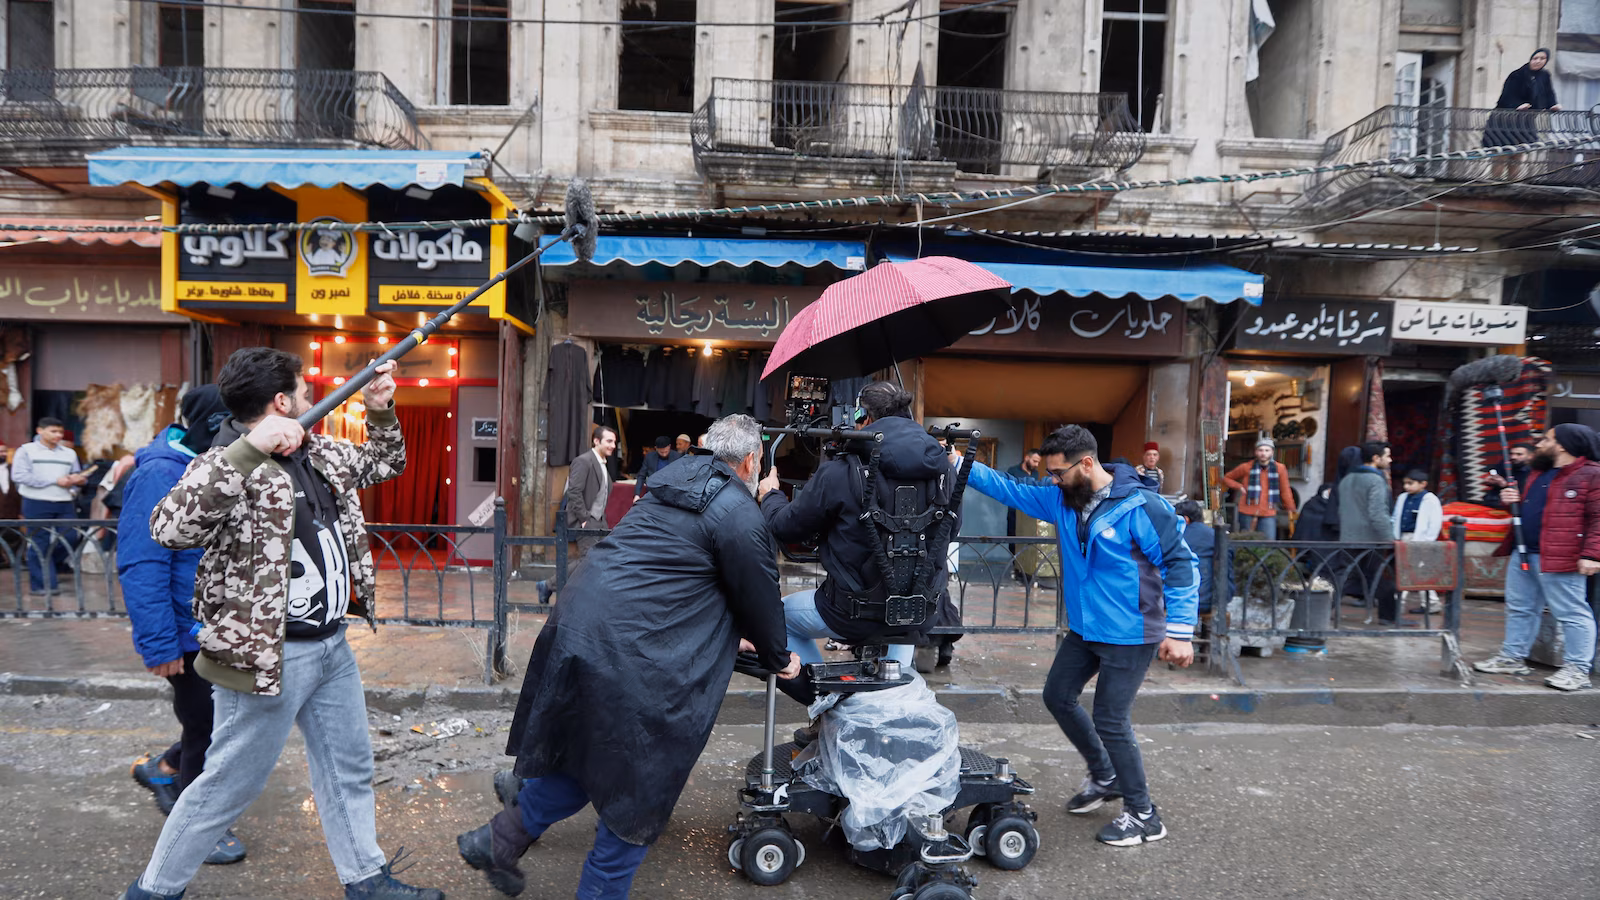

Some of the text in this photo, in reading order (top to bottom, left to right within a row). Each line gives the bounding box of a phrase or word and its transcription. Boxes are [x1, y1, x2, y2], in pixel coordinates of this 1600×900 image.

[183, 229, 289, 267] كلاوي
[25, 277, 89, 313] باب
[95, 277, 162, 313] لديات
[209, 285, 242, 298] شاورما
[248, 286, 274, 298] بطاطا
[310, 287, 350, 300] نمبر ون
[392, 289, 420, 302] فلافل
[1069, 302, 1173, 339] حلويات
[1244, 312, 1299, 340] عبدو
